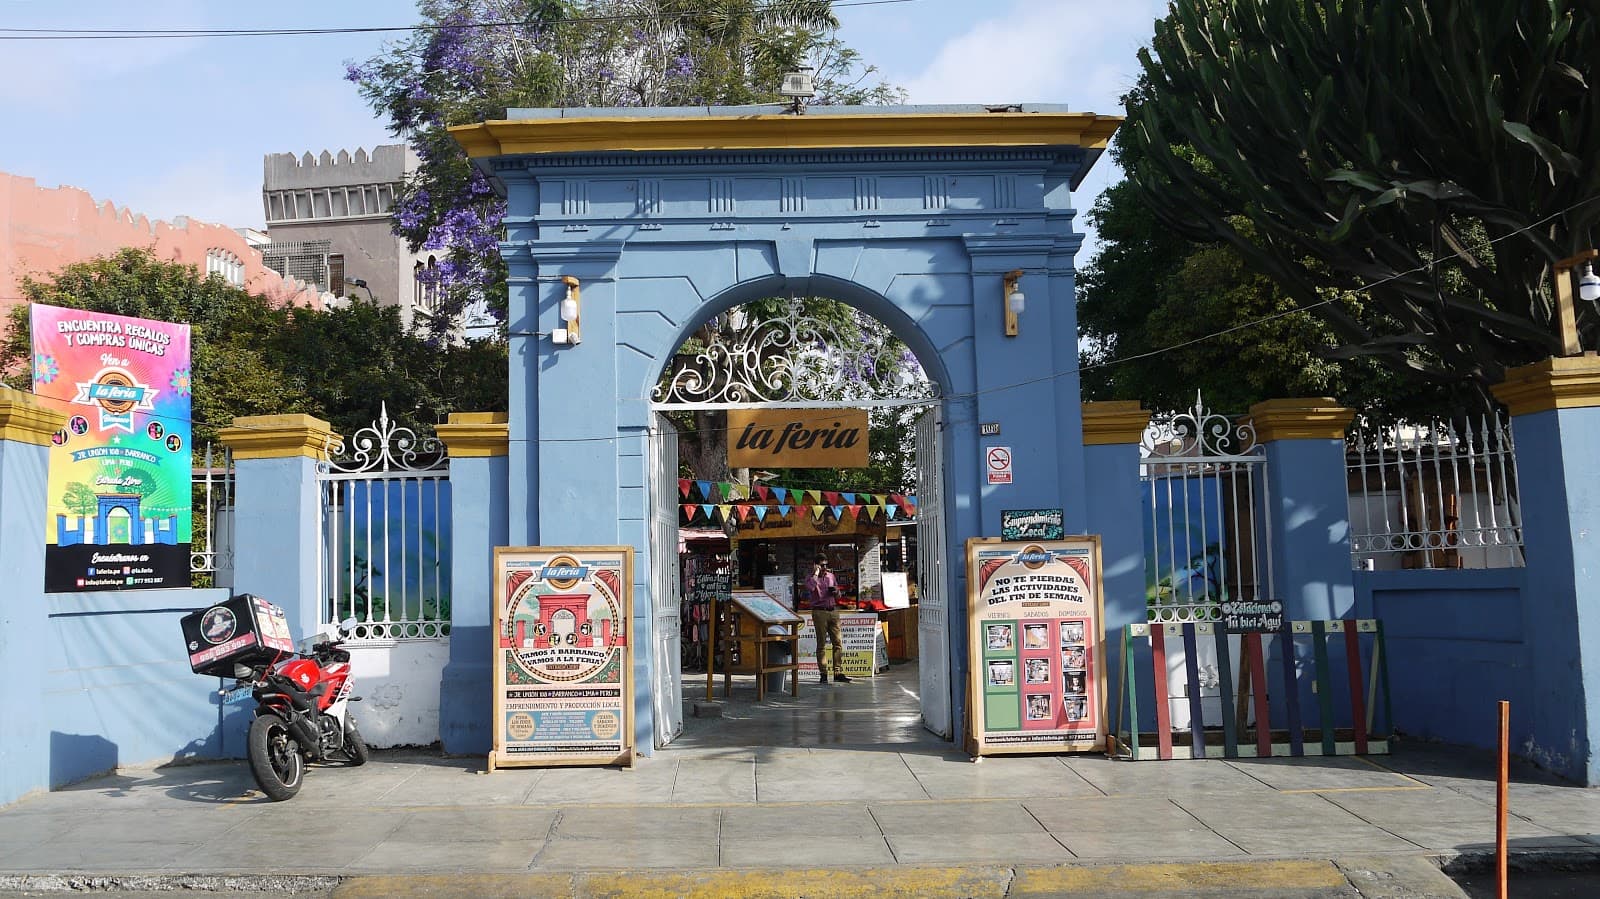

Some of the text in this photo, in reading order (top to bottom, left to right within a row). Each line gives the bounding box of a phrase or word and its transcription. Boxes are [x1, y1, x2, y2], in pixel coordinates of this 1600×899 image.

[57, 320, 171, 345] ENCUENTRA REGALOS
[64, 333, 165, 356] Y COMPRAS ÚNICAS
[100, 353, 120, 366] Ven
[95, 386, 137, 400] la feria
[736, 422, 860, 454] la feria
[124, 449, 156, 463] BARRANCO
[1003, 512, 1061, 528] Emprendimiento
[1019, 523, 1047, 536] Local
[546, 567, 580, 577] la feria
[995, 578, 1011, 586] NO
[1029, 575, 1075, 584] PIERDAS
[992, 584, 1079, 596] LAS ACTIVIDADES
[988, 592, 1083, 605] DEL FIN DE SEMANA
[520, 650, 548, 659] VAMOS
[527, 657, 554, 665] VAMOS
[506, 702, 558, 710] EMPRENDIMIENTO
